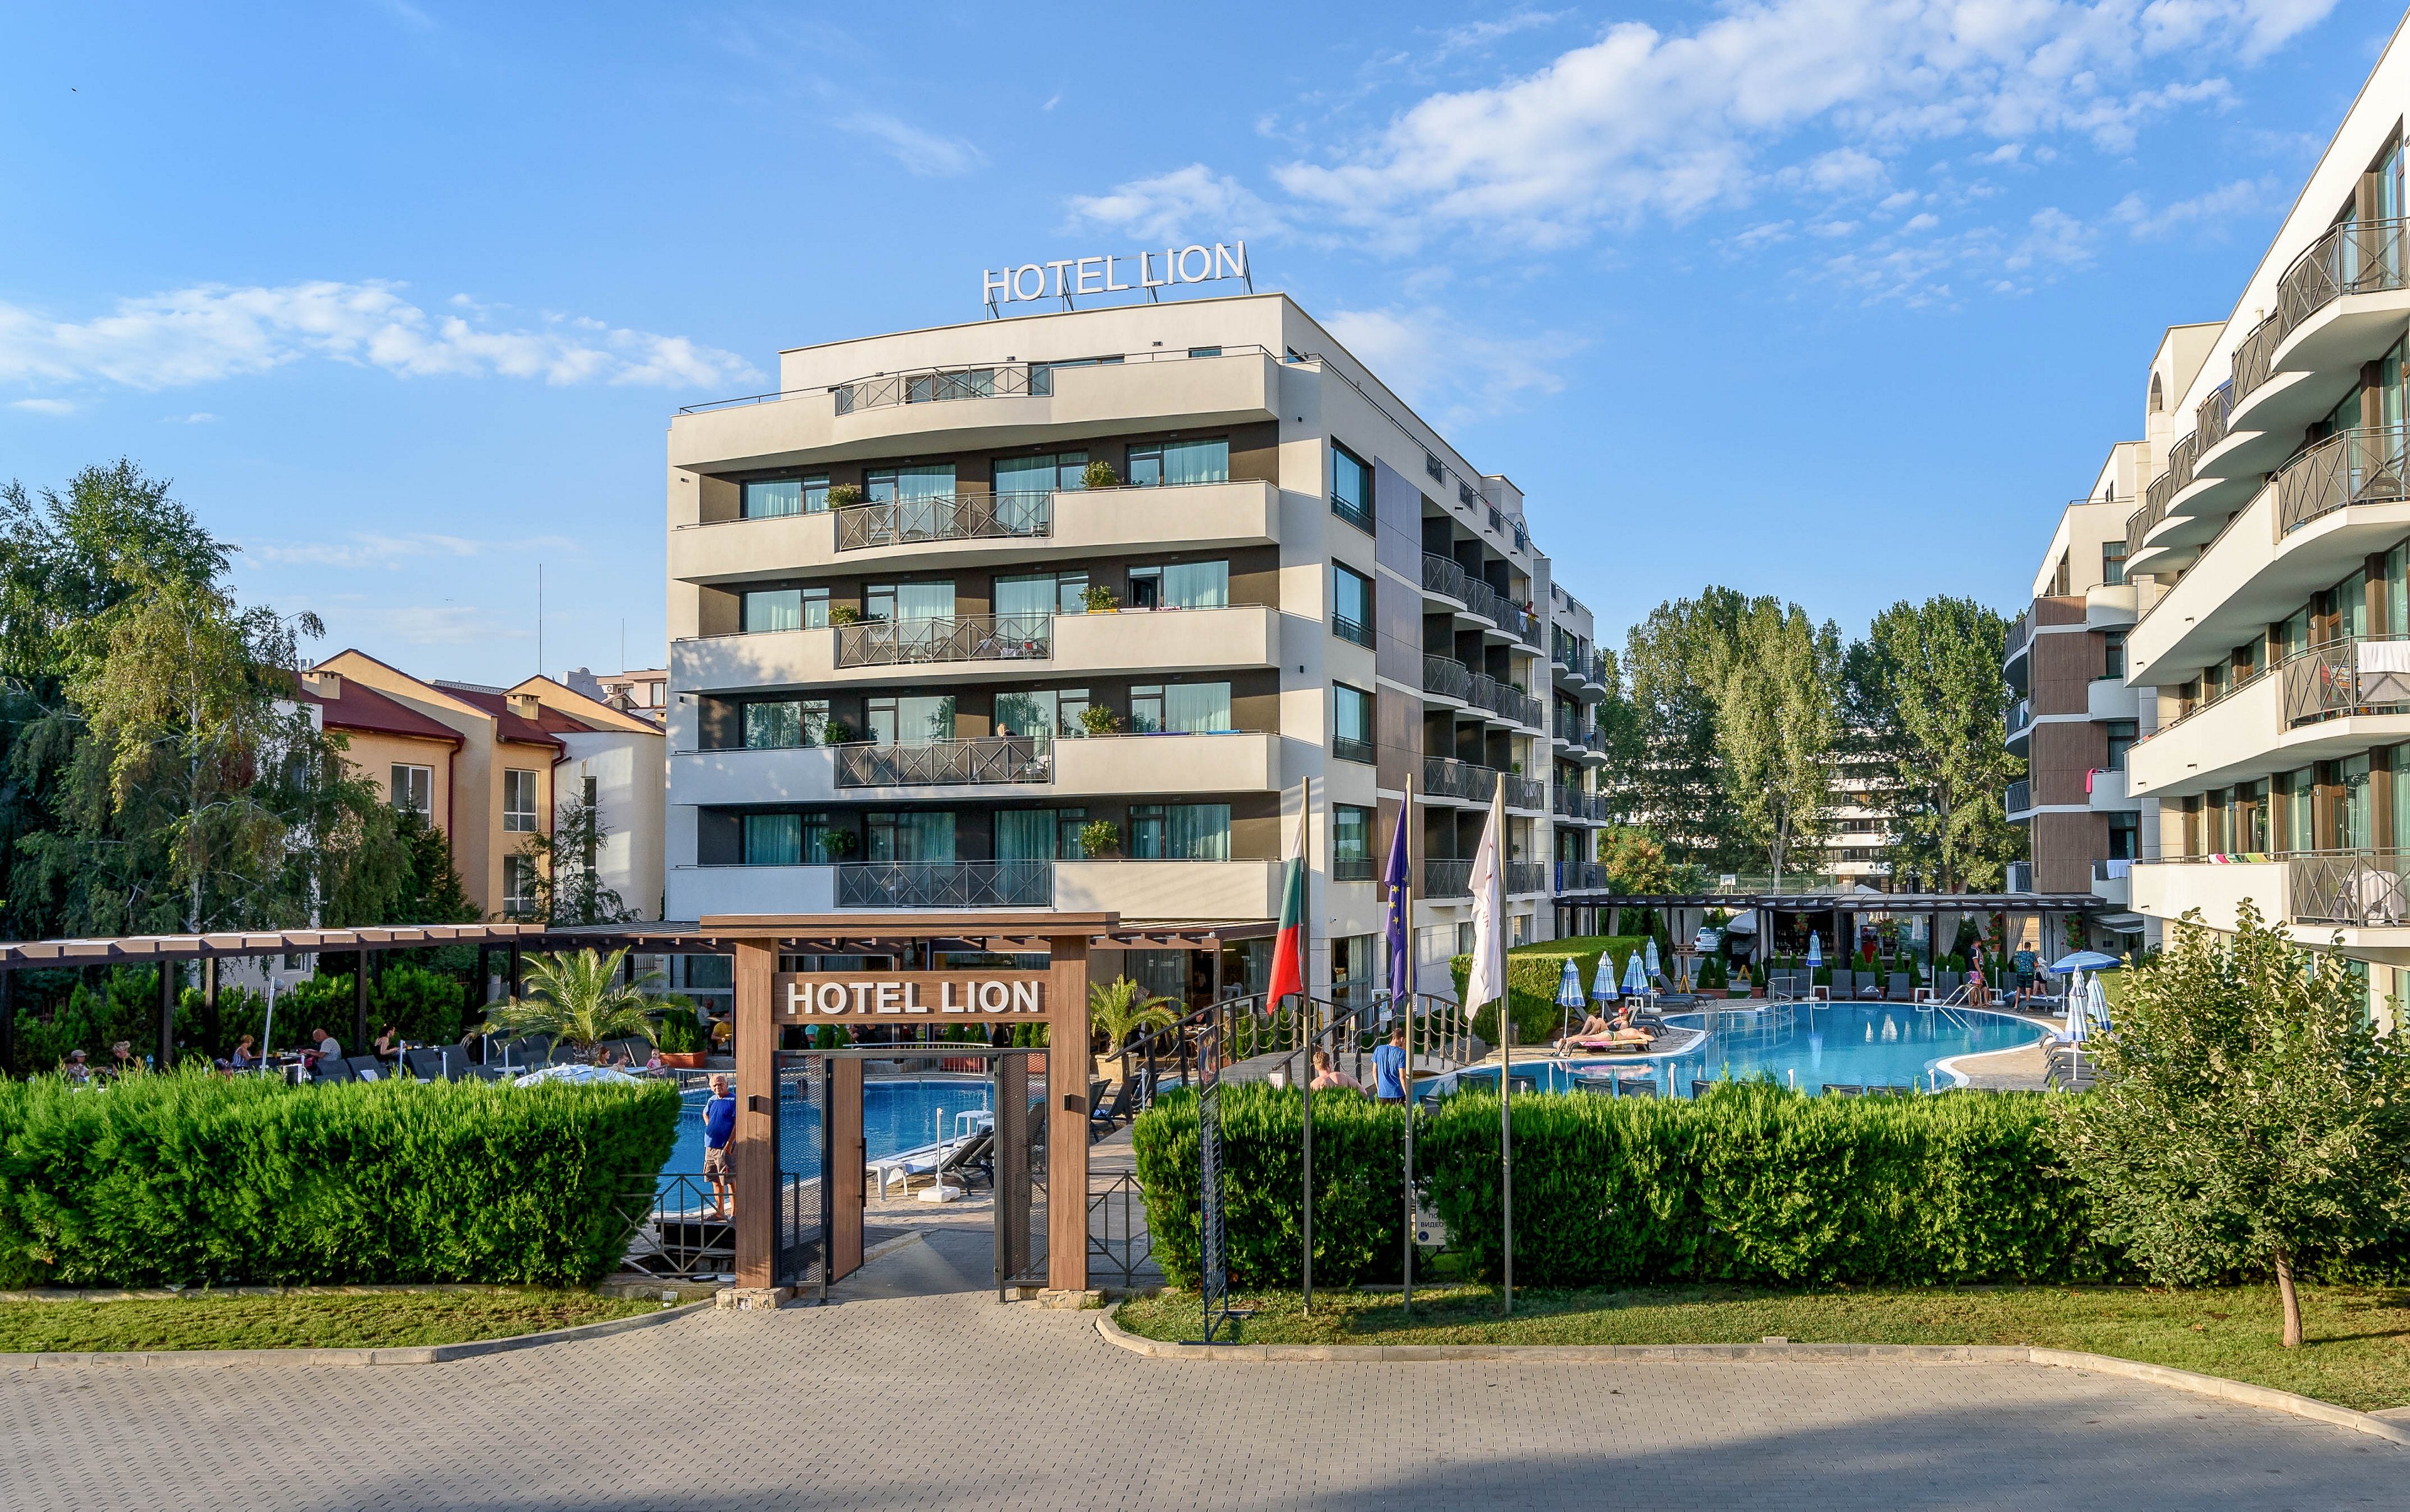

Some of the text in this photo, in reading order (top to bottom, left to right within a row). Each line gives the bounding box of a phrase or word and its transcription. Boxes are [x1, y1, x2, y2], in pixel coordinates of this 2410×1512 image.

[983, 240, 1245, 304] HOTEL LION
[788, 980, 1039, 1014] HOTEL LION
